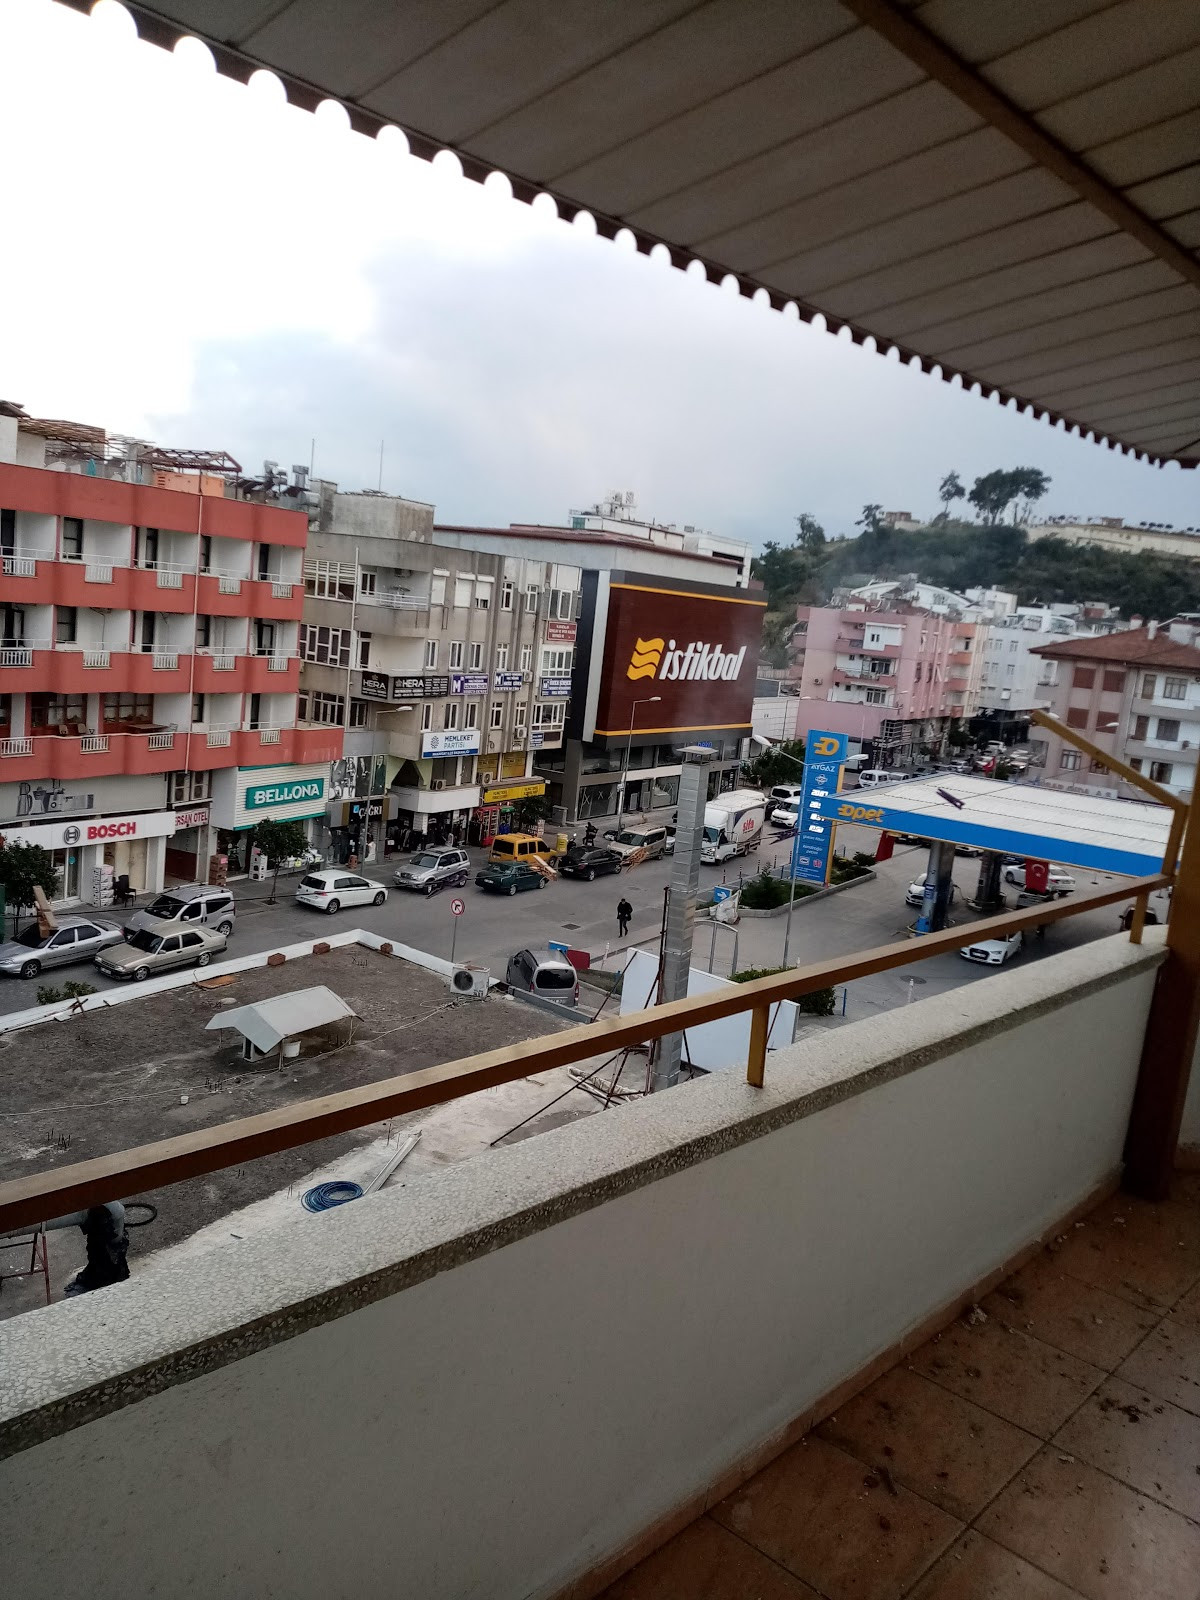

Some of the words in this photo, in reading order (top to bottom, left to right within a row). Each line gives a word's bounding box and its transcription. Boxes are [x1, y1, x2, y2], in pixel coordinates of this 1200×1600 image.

[659, 639, 747, 680] istikbal
[363, 679, 386, 689] HERA
[402, 679, 424, 688] HERA
[444, 734, 474, 742] MEMLEKET
[811, 764, 836, 773] AYGAZ
[254, 783, 320, 805] BELLONA
[175, 813, 193, 827] RSAN
[193, 811, 208, 823] OTEL
[87, 822, 137, 840] BOSCH
